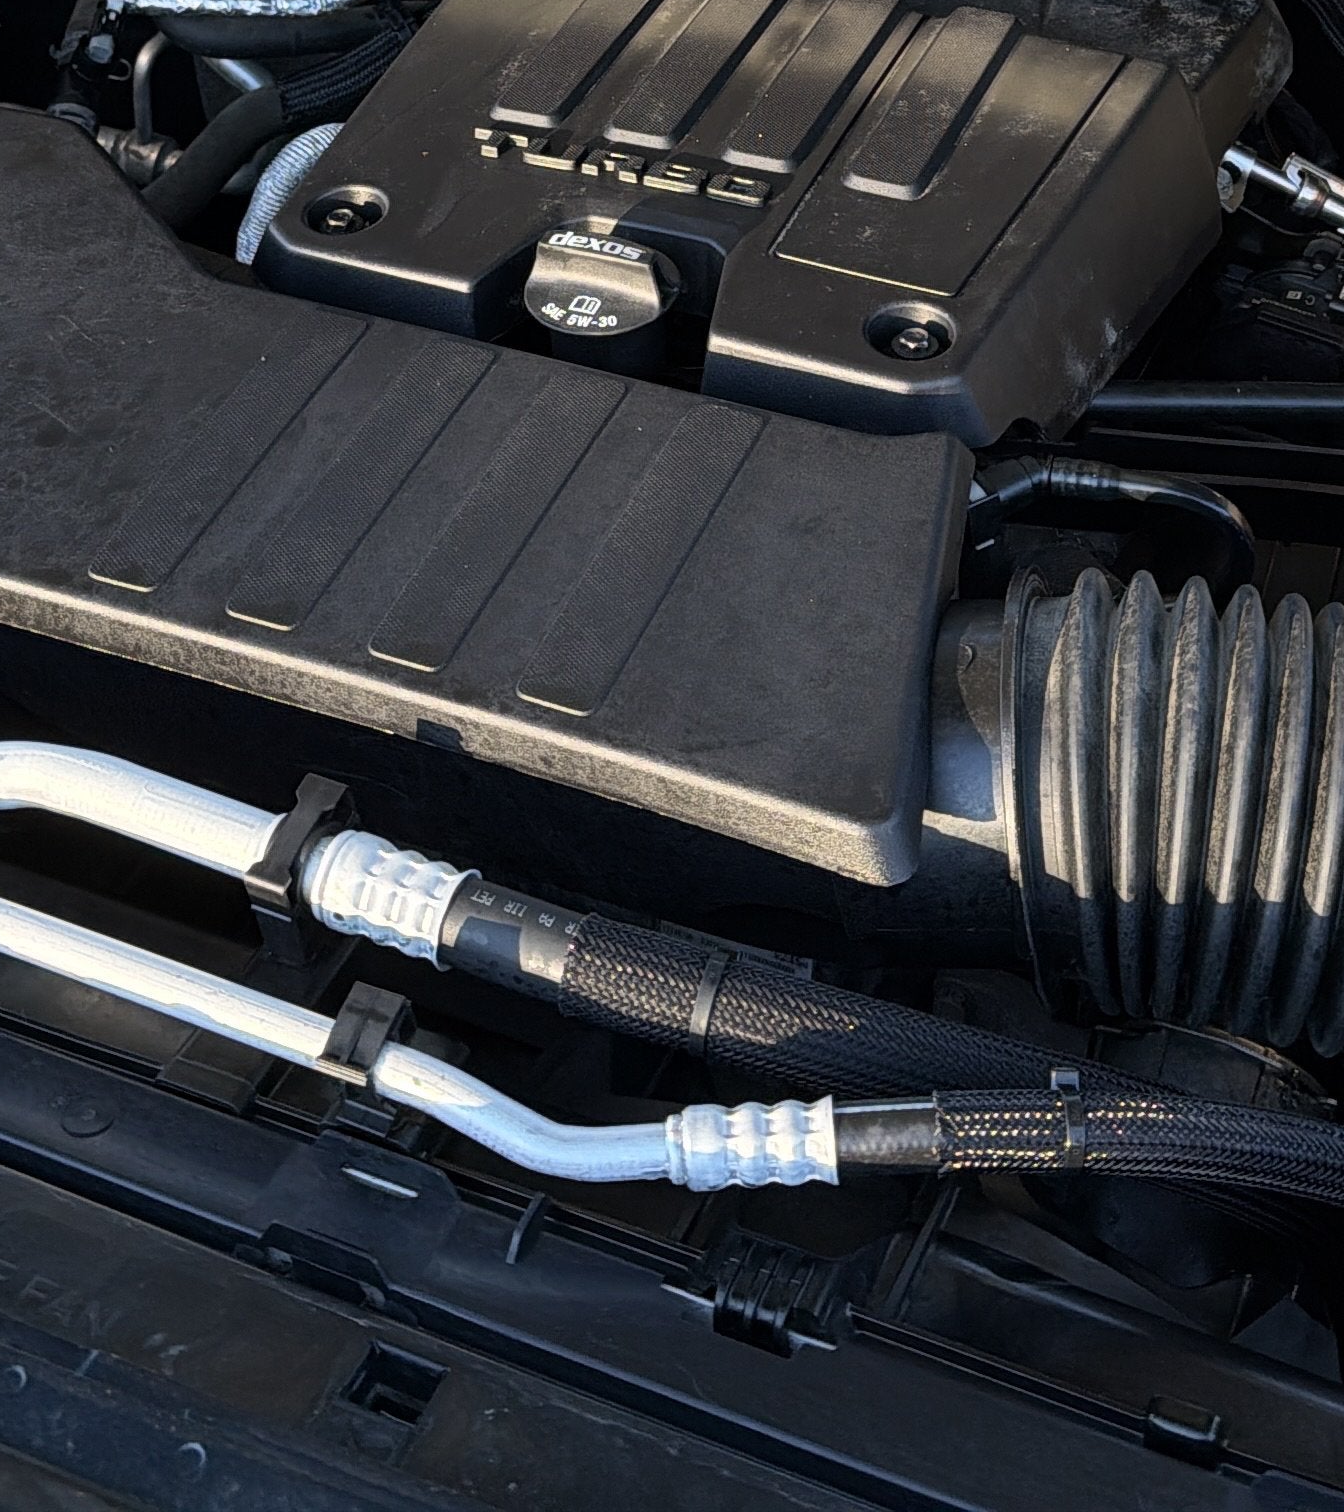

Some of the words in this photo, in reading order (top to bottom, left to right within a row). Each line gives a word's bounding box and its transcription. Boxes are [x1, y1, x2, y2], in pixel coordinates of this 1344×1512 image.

[548, 231, 643, 261] dexos
[542, 302, 567, 322] SAE
[566, 314, 618, 329] 5W-30
